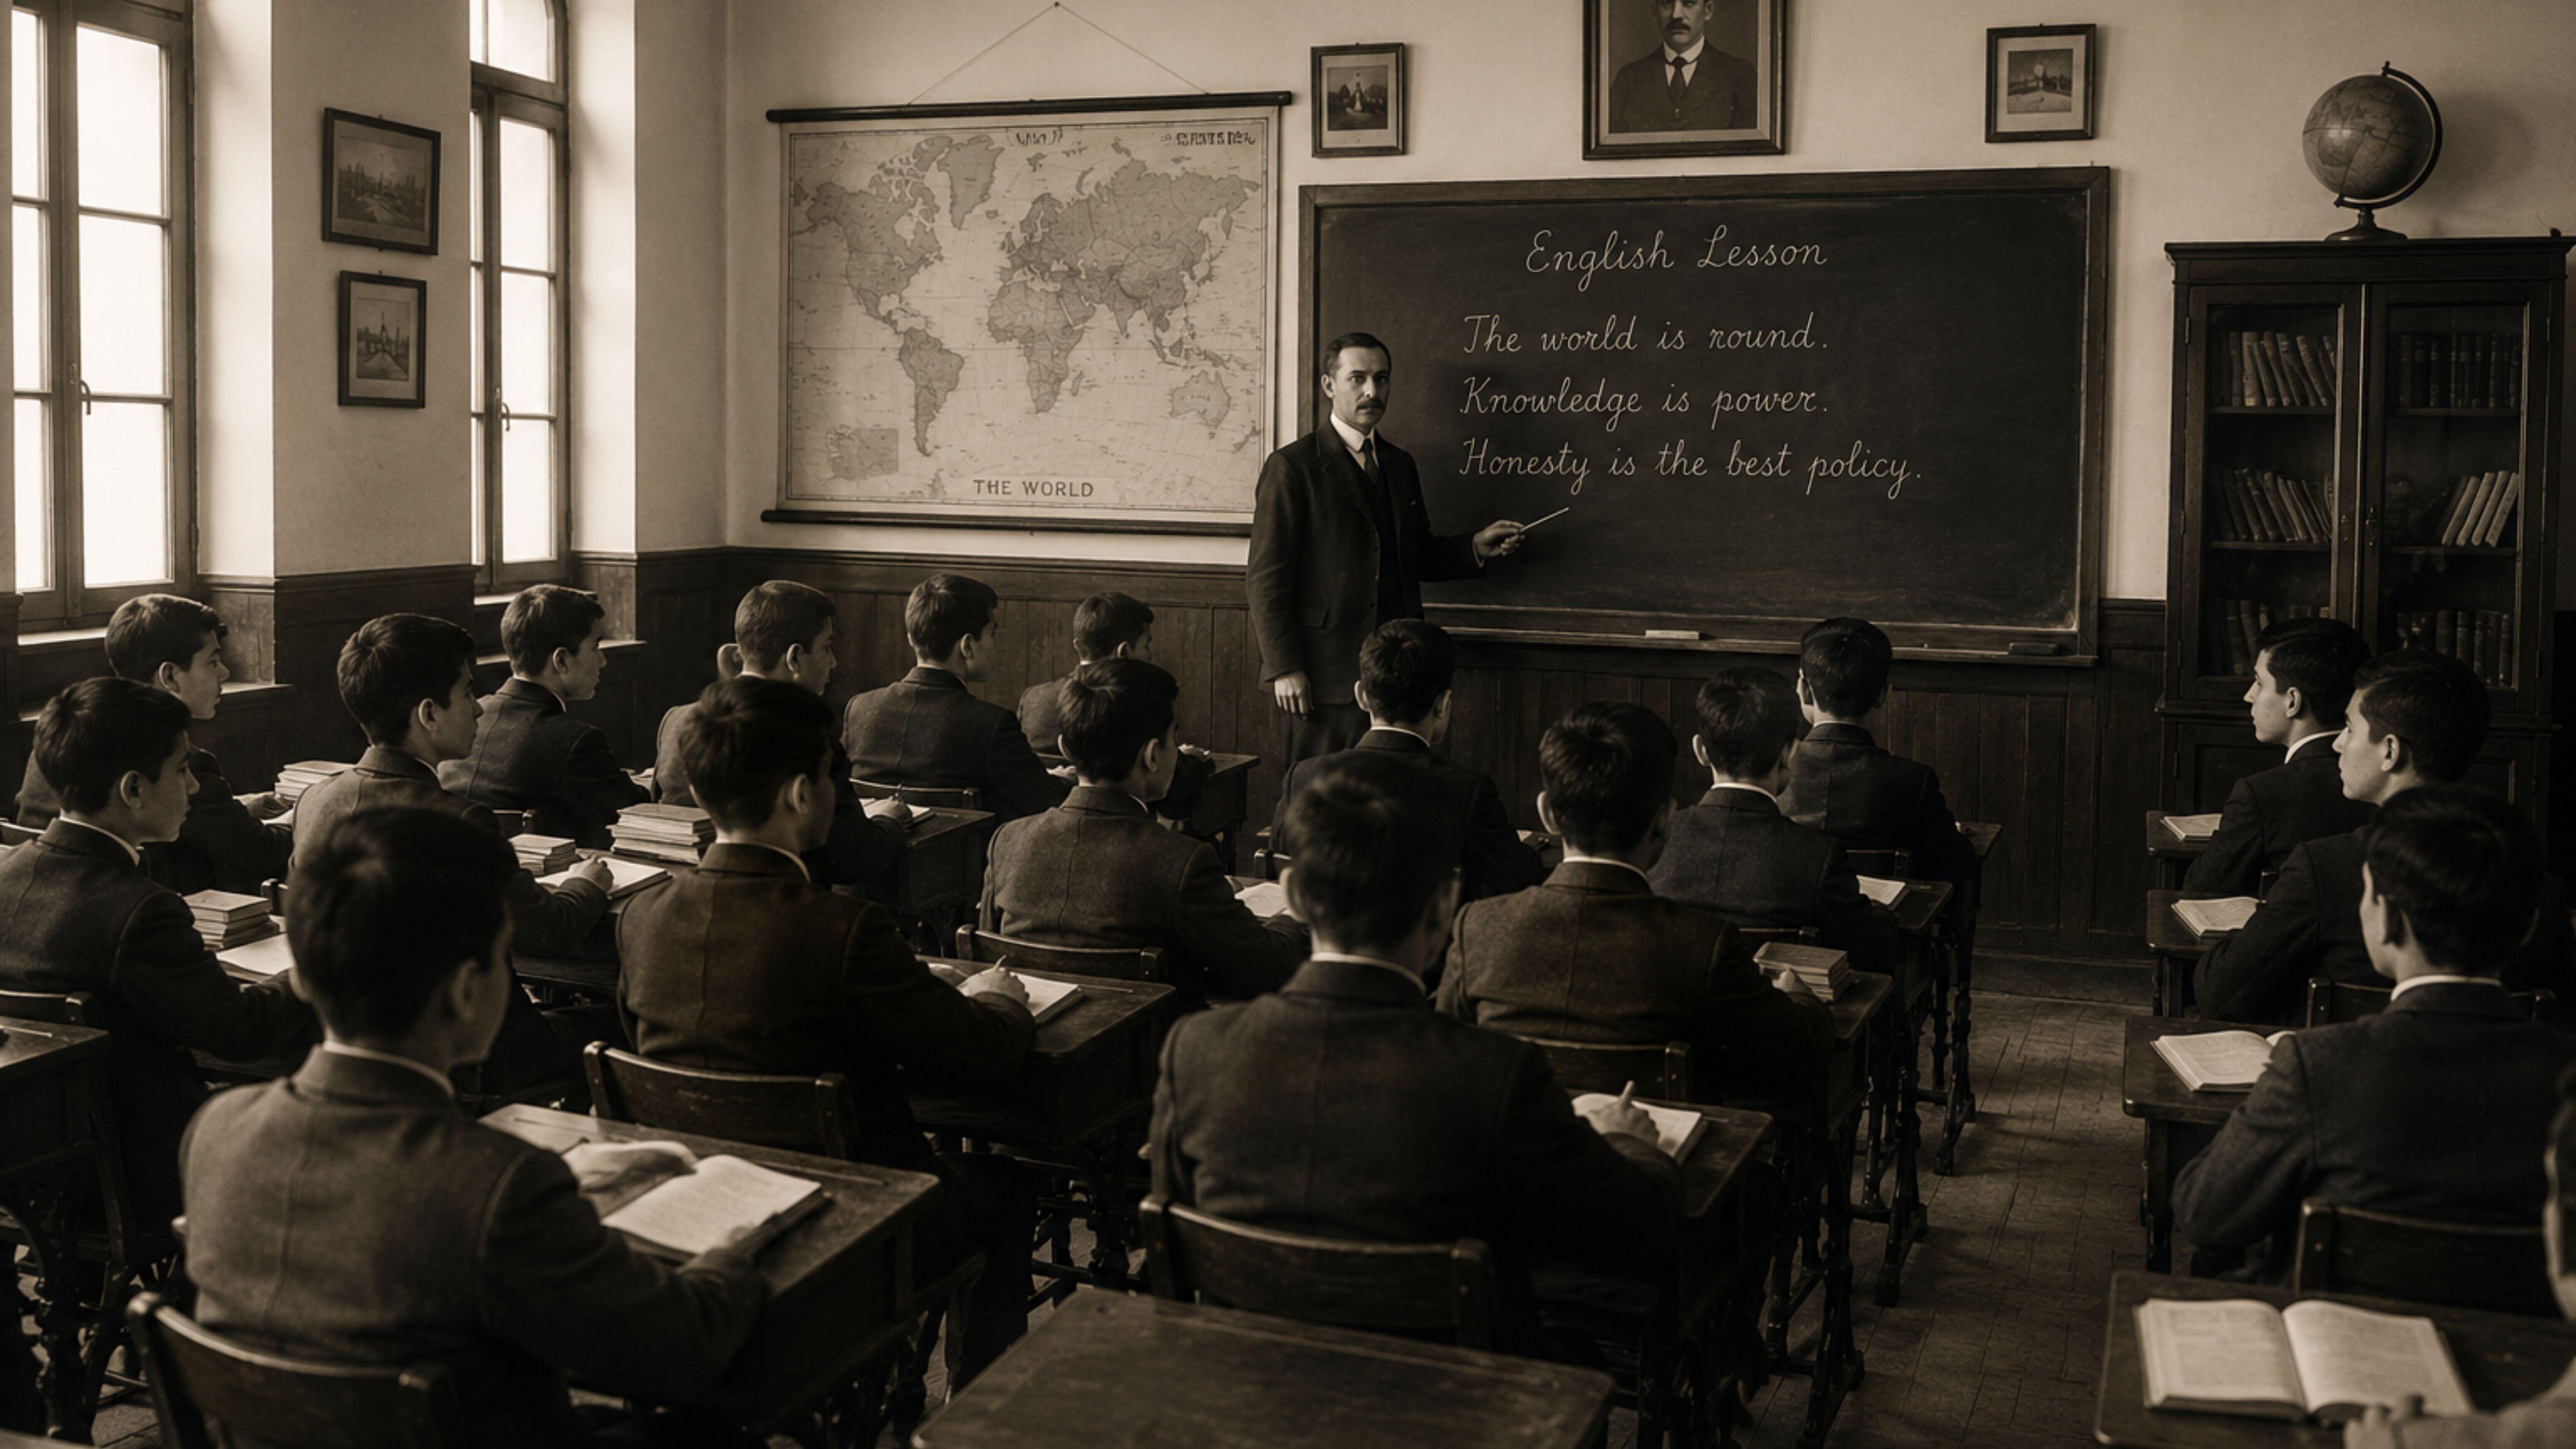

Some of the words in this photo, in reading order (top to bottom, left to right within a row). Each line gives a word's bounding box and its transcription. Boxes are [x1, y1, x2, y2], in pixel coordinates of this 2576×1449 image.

[1525, 229, 1675, 292] English
[1696, 224, 1828, 268] Lesson
[1463, 313, 1522, 354] The
[1540, 313, 1638, 352] world
[1656, 320, 1686, 350] is
[1708, 311, 1828, 350] round.
[1459, 376, 1643, 433] Knowledge
[1660, 383, 1690, 413] is
[1710, 389, 1828, 430] power.
[972, 479, 1012, 496] THE
[1021, 480, 1095, 498] WORLD
[1458, 437, 1591, 496] Honesty
[1607, 447, 1636, 476] is
[1654, 438, 1708, 477] the
[1725, 438, 1792, 478] best
[1805, 439, 1922, 500] policy.
